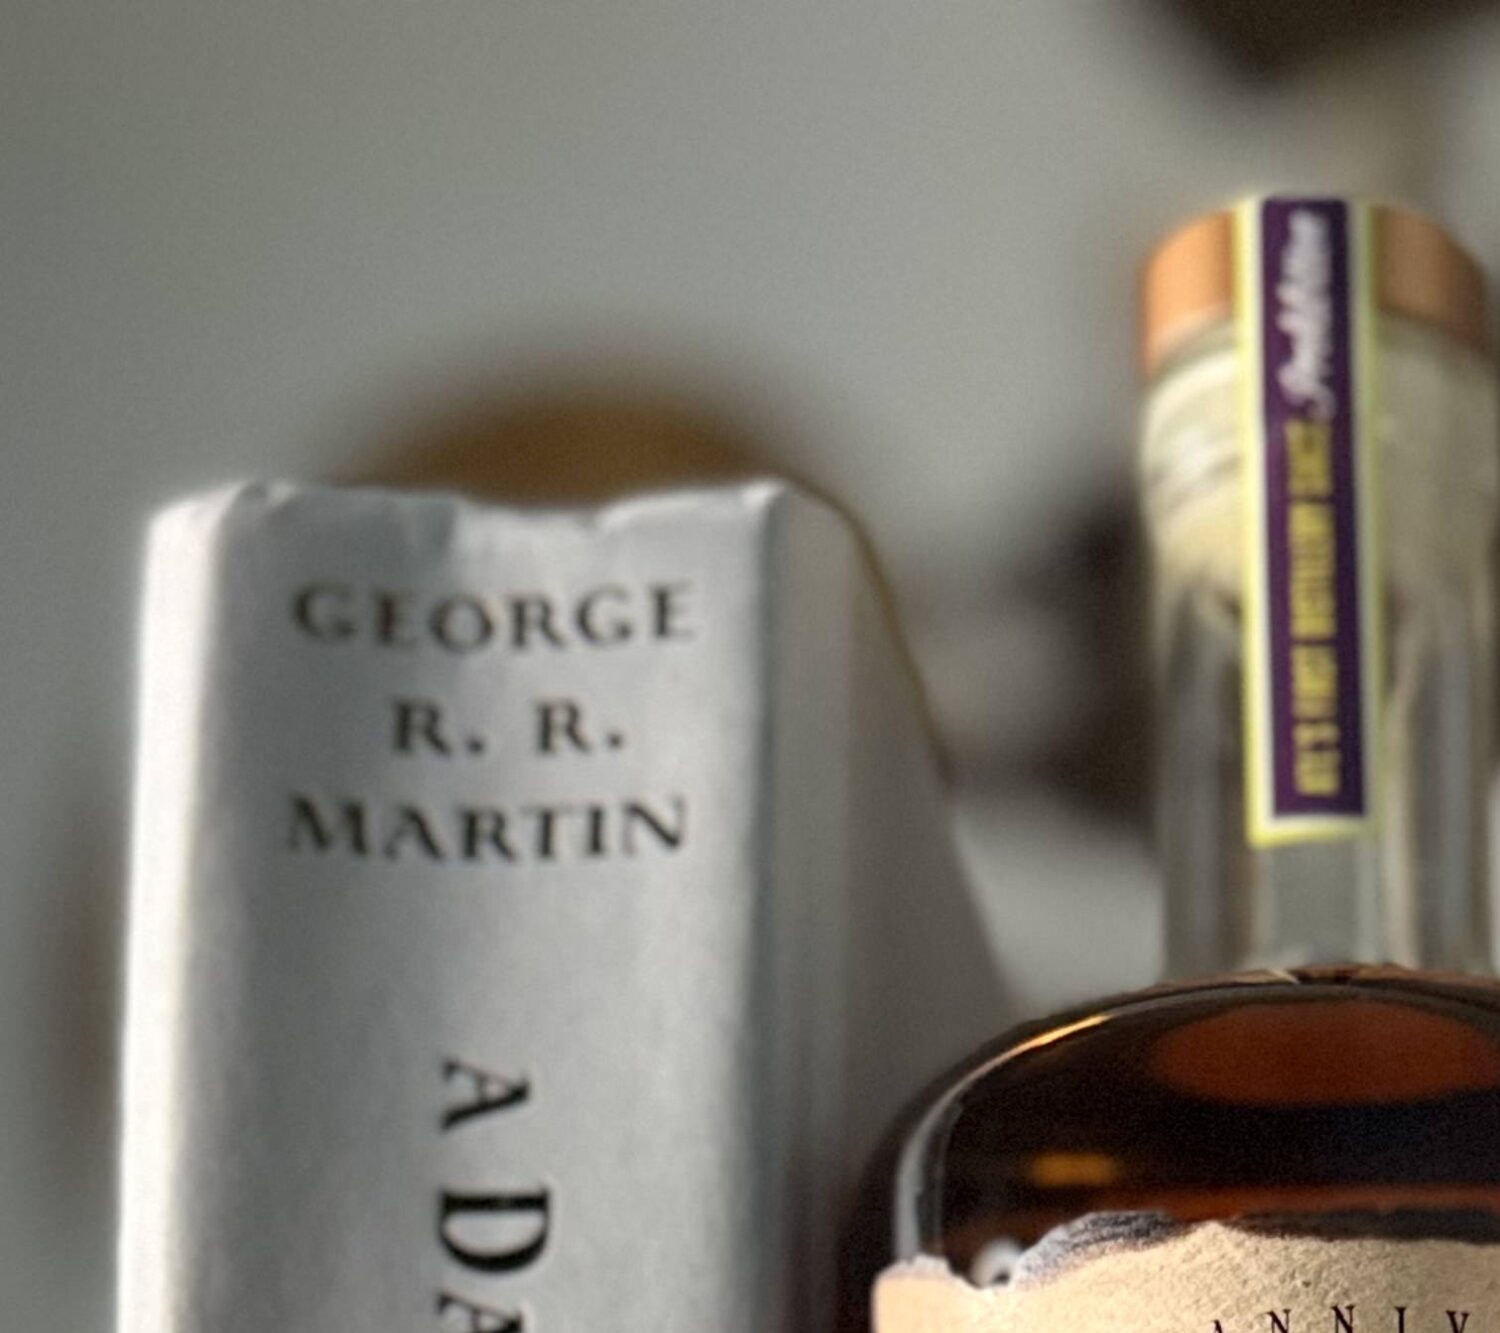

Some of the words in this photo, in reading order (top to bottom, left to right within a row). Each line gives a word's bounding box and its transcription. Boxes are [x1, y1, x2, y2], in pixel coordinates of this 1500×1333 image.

[290, 580, 699, 654] GEORGE
[391, 700, 484, 757] R.
[534, 700, 626, 755] R.
[285, 793, 687, 862] MARTIN
[441, 1057, 533, 1134] A
